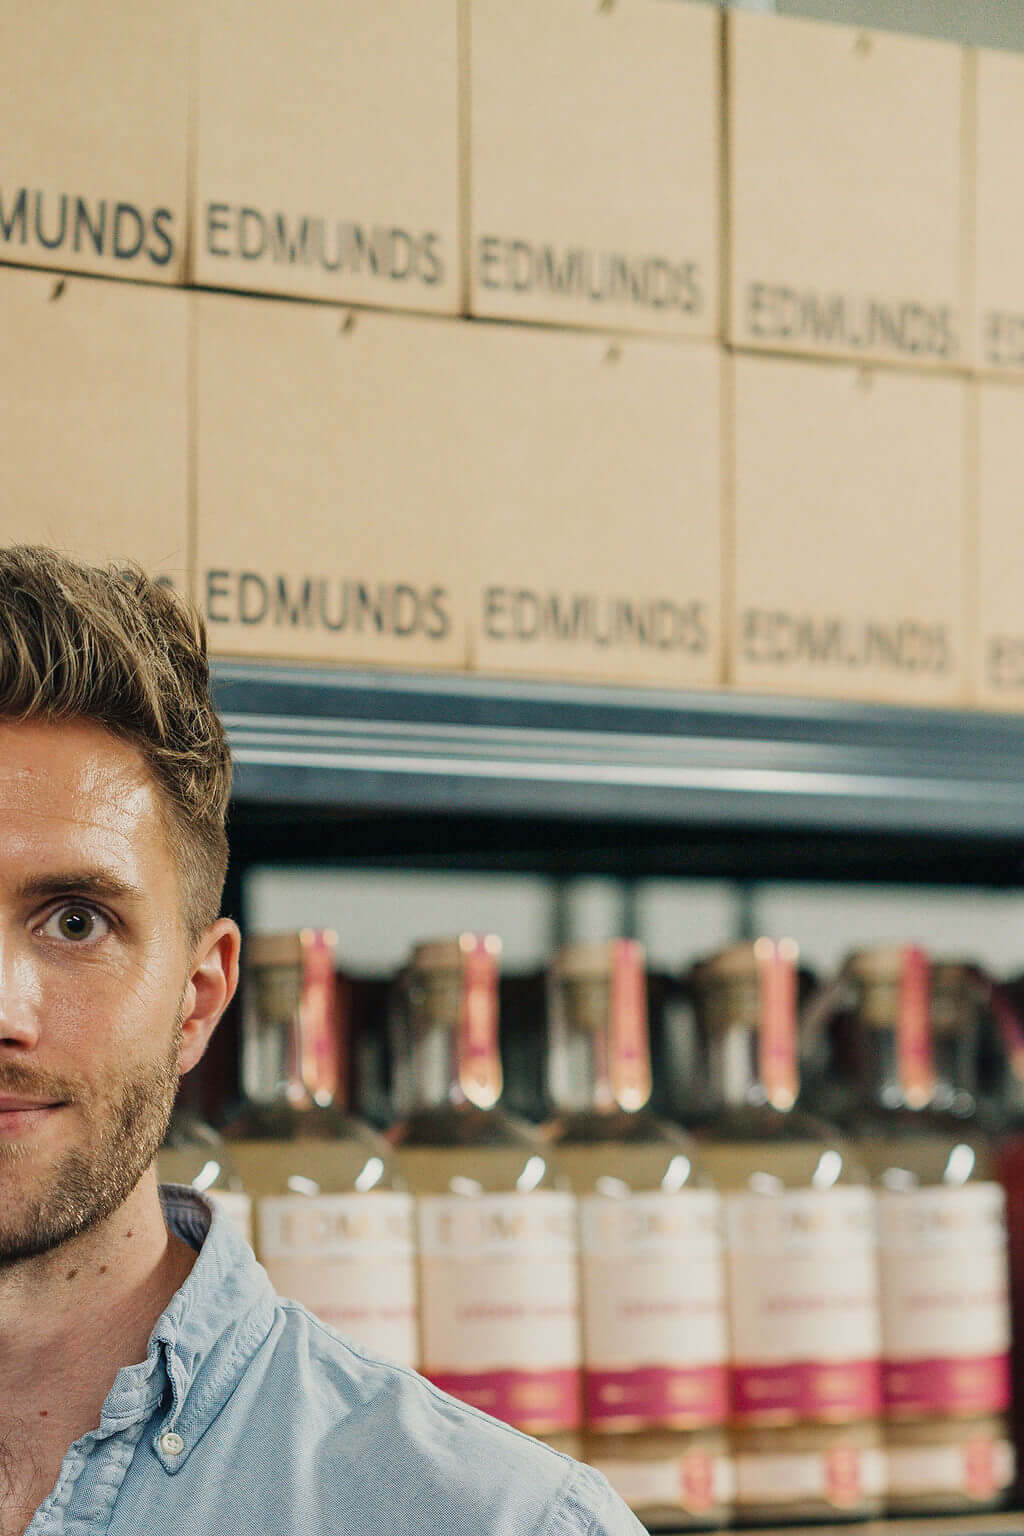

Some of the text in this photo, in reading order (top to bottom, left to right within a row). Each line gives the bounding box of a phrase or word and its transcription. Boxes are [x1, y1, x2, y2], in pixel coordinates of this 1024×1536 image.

[206, 201, 445, 287] EDMUNDS
[479, 236, 704, 314] EDMUNDS
[206, 568, 450, 641] EDMUNDS
[482, 585, 709, 655] EDMUNDS
